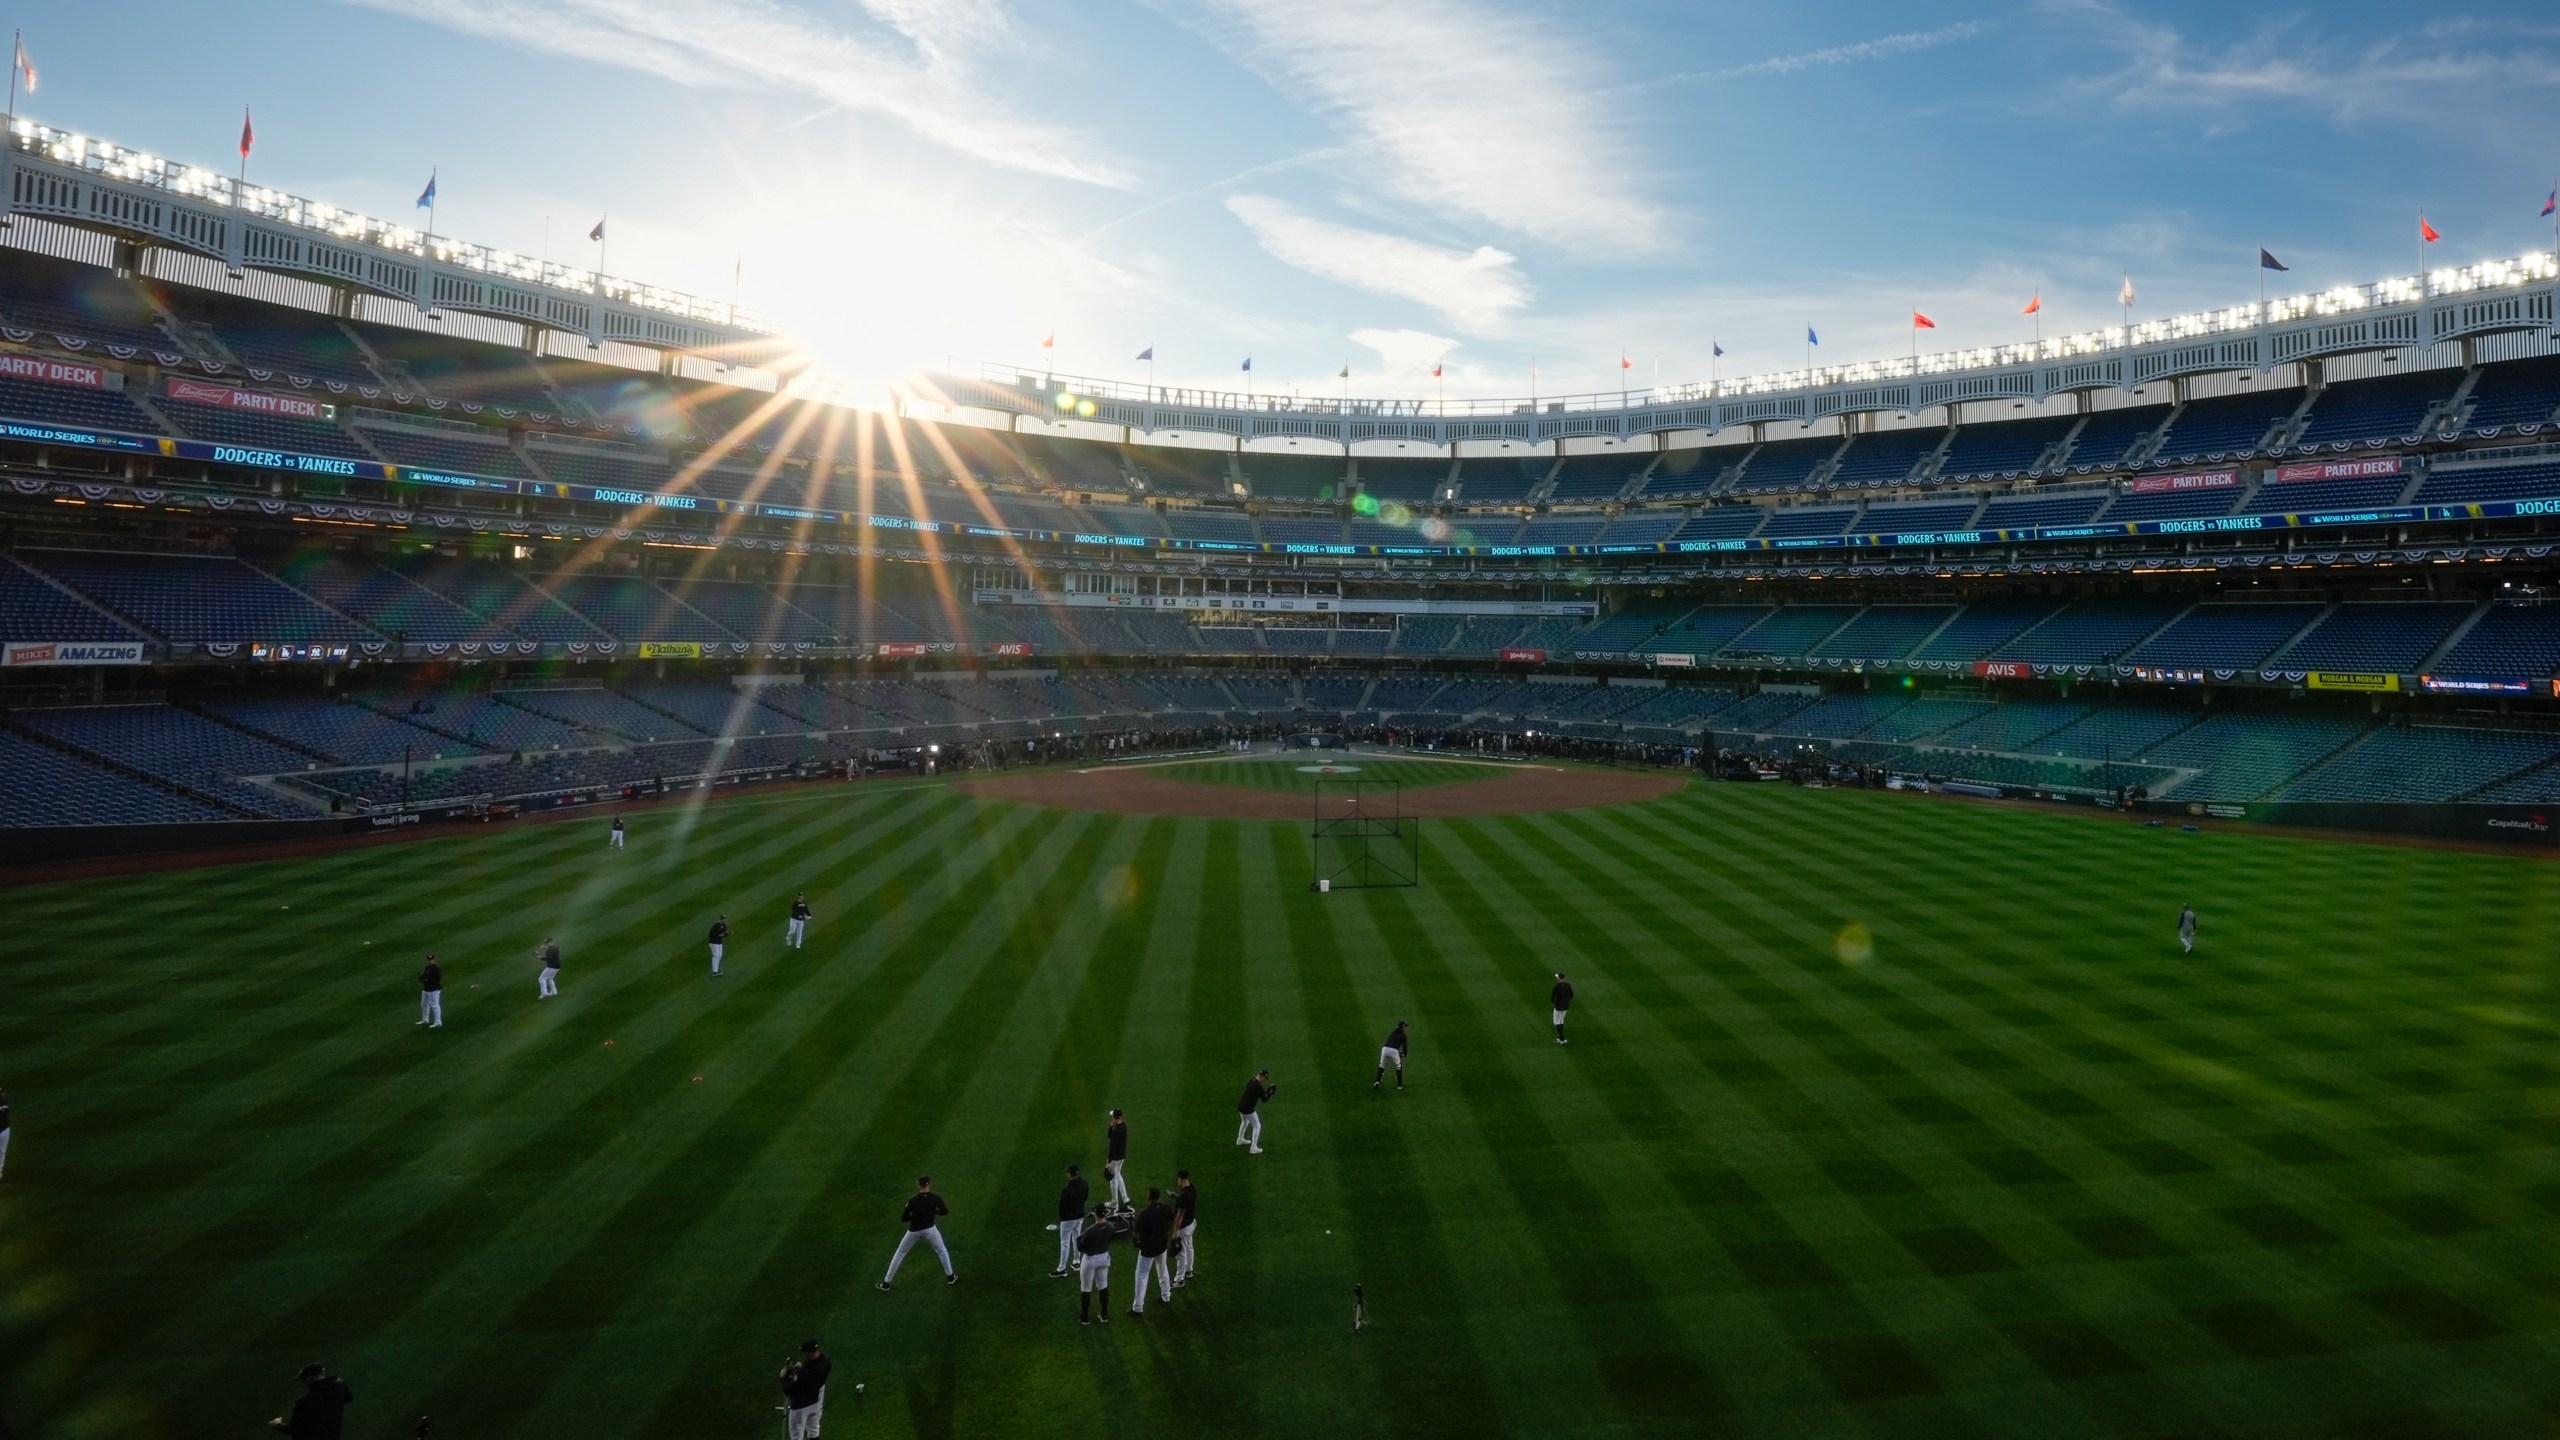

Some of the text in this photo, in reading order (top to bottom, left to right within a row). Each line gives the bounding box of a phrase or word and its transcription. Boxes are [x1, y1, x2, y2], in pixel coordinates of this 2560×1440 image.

[0, 357, 96, 384] ARTY DECK
[233, 392, 277, 410] PARTY
[280, 399, 316, 416] DECK
[8, 425, 53, 439] WORLD
[54, 431, 96, 444] SERIES
[214, 447, 282, 467] DODGERS
[298, 457, 355, 475] YANKEES
[2325, 464, 2360, 476] PARTY
[2363, 461, 2394, 474] DECK
[422, 473, 450, 483] WORLD
[451, 477, 476, 486] SERIES
[2173, 476, 2203, 488] PARTY
[2205, 474, 2232, 485] DECK
[595, 489, 643, 504] DODGERS
[654, 495, 696, 509] YANKEES
[774, 508, 795, 517] WORLD
[2351, 513, 2378, 521] SERIES
[869, 516, 902, 528] DODGERS
[909, 520, 939, 531] YANKEES
[2160, 520, 2205, 532] DODGERS
[2216, 518, 2261, 530] YANKEES
[1075, 534, 1107, 544] DODGERS
[1114, 536, 1145, 546] YANKEES
[1898, 534, 1935, 544] DODGERS
[1943, 533, 1980, 542] YANKEES
[1287, 544, 1318, 553] DODGERS
[1326, 545, 1355, 553] YANKEES
[1492, 547, 1521, 555] DODGERS
[1680, 542, 1710, 551] DODGERS
[1717, 541, 1746, 550] YANKEES
[16, 647, 137, 660] MIKE'S AMAZING
[252, 648, 266, 656] LAD
[333, 648, 348, 656] NYY
[998, 644, 1021, 654] AVIS
[1987, 664, 2016, 676] AVIS
[2322, 674, 2348, 682] MORGAN
[2356, 675, 2383, 684] MORGAN
